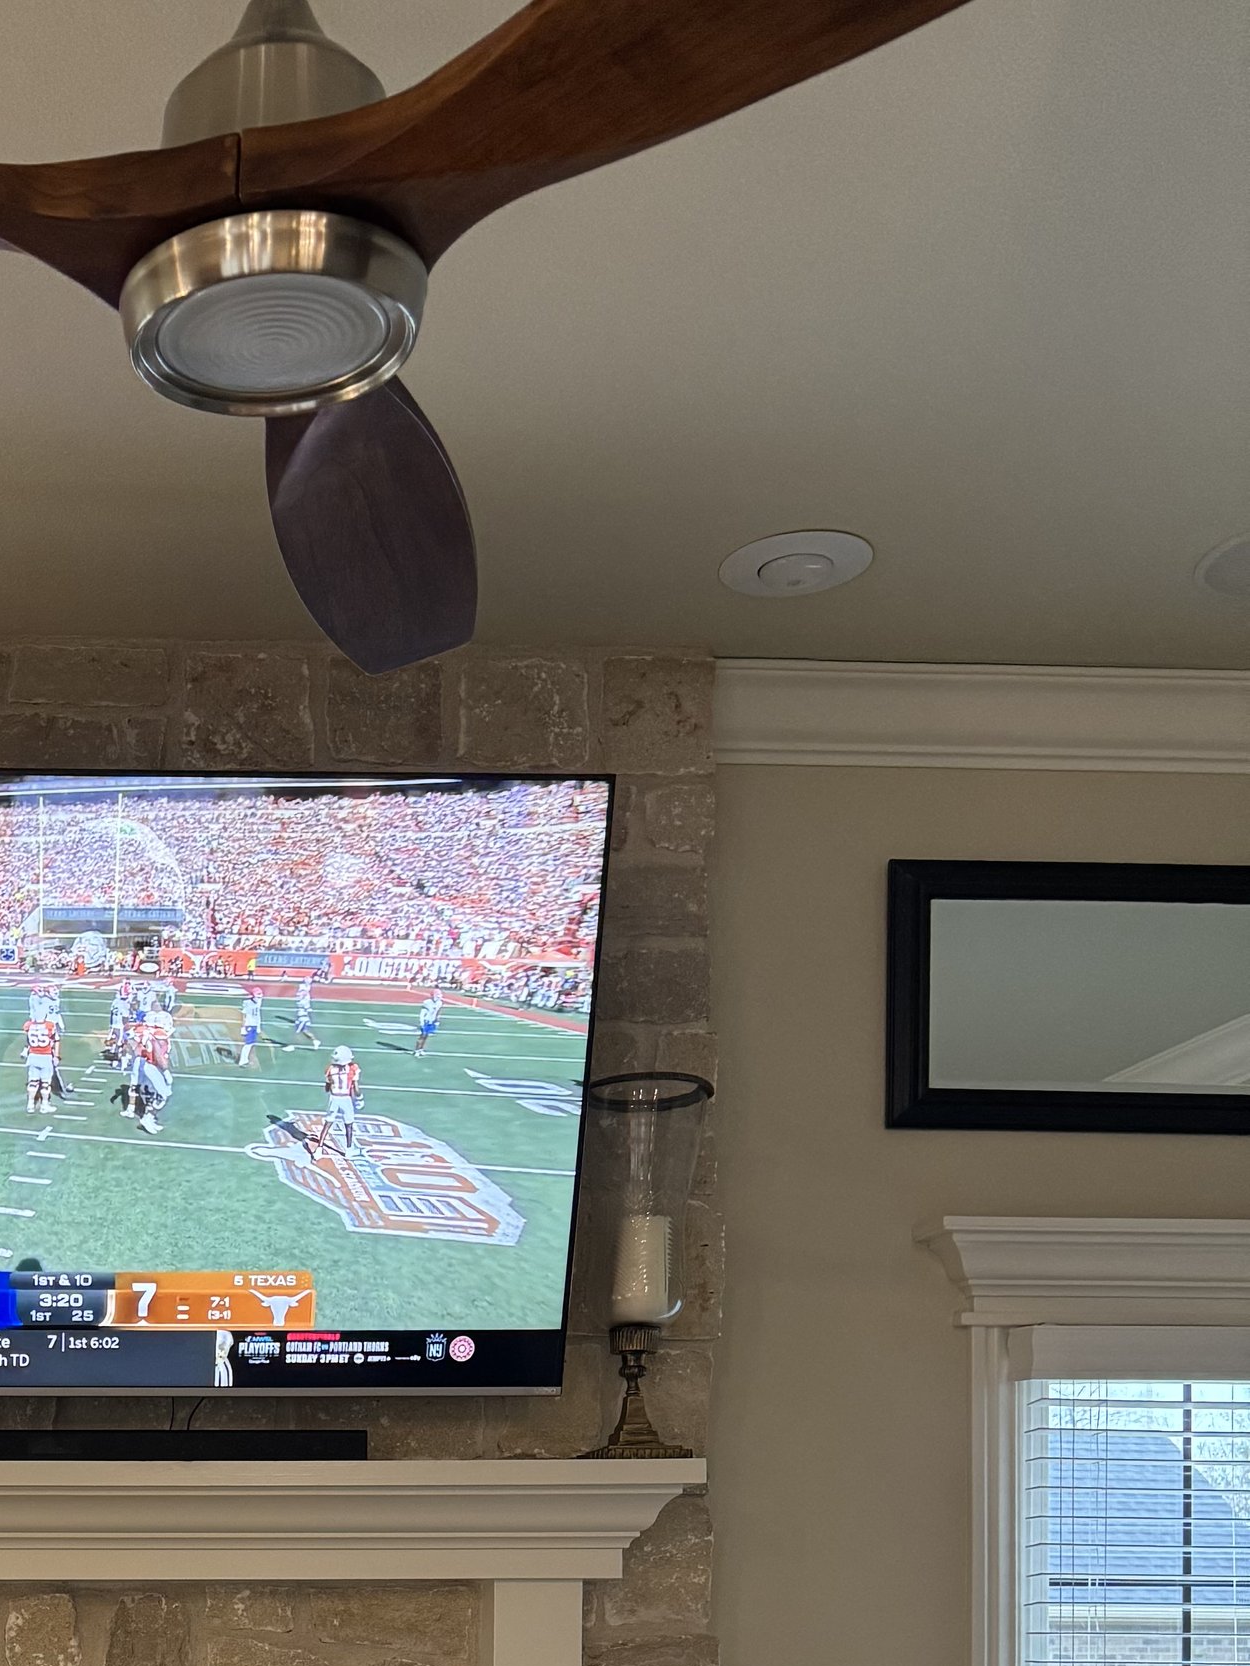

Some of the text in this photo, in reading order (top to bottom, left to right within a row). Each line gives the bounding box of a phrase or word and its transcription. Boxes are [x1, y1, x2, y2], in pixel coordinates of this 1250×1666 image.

[59, 1274, 71, 1286] &
[74, 1274, 92, 1286] 10
[249, 1275, 297, 1286] TEXAS
[39, 1293, 83, 1307] 3:20
[131, 1282, 157, 1317] 7
[210, 1296, 230, 1308] 7-1
[71, 1310, 94, 1322] 25
[207, 1310, 231, 1320] (3-1)
[47, 1335, 57, 1349] 7
[68, 1337, 119, 1349] 1st 6:02
[239, 1342, 280, 1354] PLAYOFFS
[430, 1343, 442, 1357] NY
[10, 1354, 30, 1367] TD
[286, 1354, 317, 1363] SUNDAY
